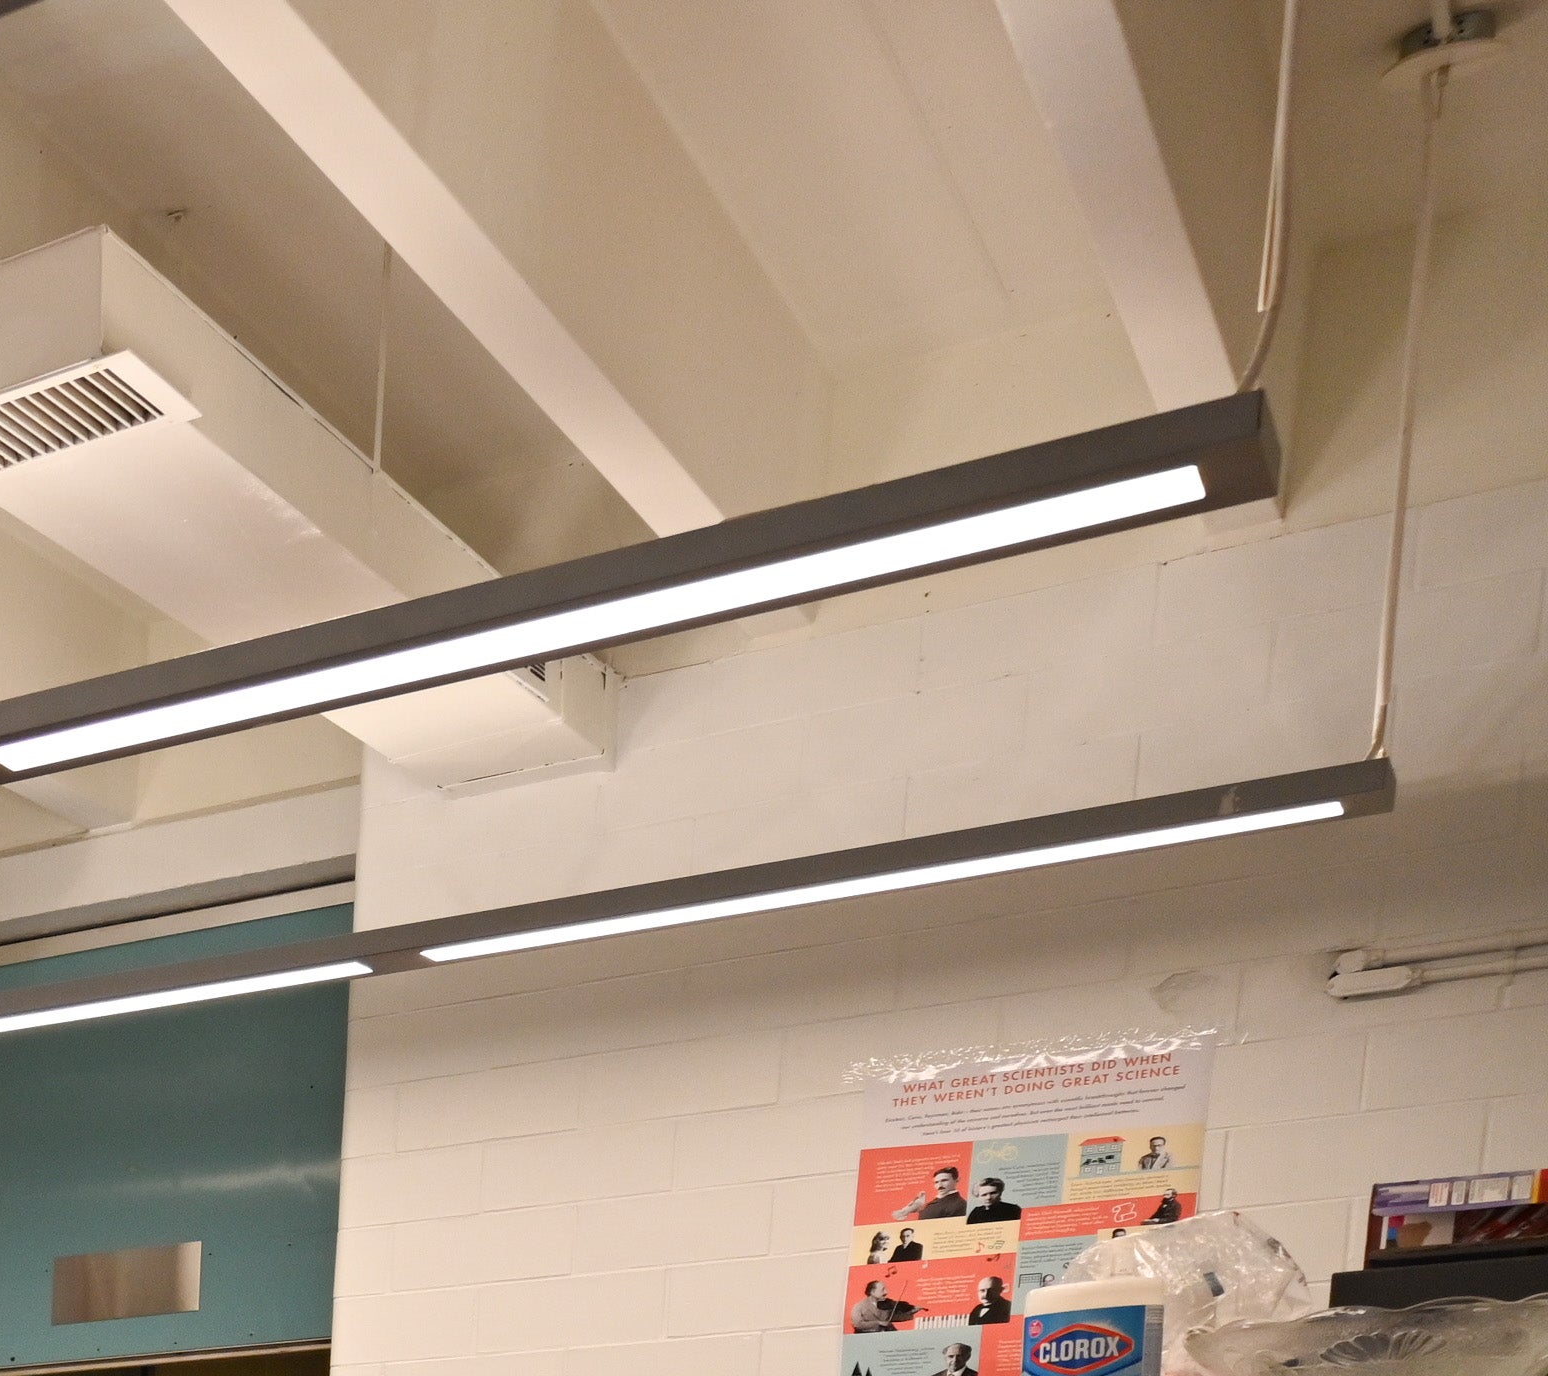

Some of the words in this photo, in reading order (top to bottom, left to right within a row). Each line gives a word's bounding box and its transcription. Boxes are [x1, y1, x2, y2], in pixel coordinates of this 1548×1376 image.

[892, 1094, 927, 1108] THEY
[933, 1085, 998, 1104] WEREN'T
[1003, 1080, 1054, 1096] DOING
[1062, 1073, 1111, 1088] GREAT
[1116, 1064, 1181, 1083] SCIENCE
[902, 1079, 946, 1094] WHAT
[950, 1074, 996, 1089] GREAT
[1002, 1063, 1085, 1083] SCIENTISTS
[1091, 1059, 1118, 1072] DID
[1123, 1053, 1173, 1068] WHEN
[1038, 1335, 1120, 1364] CLOROX
